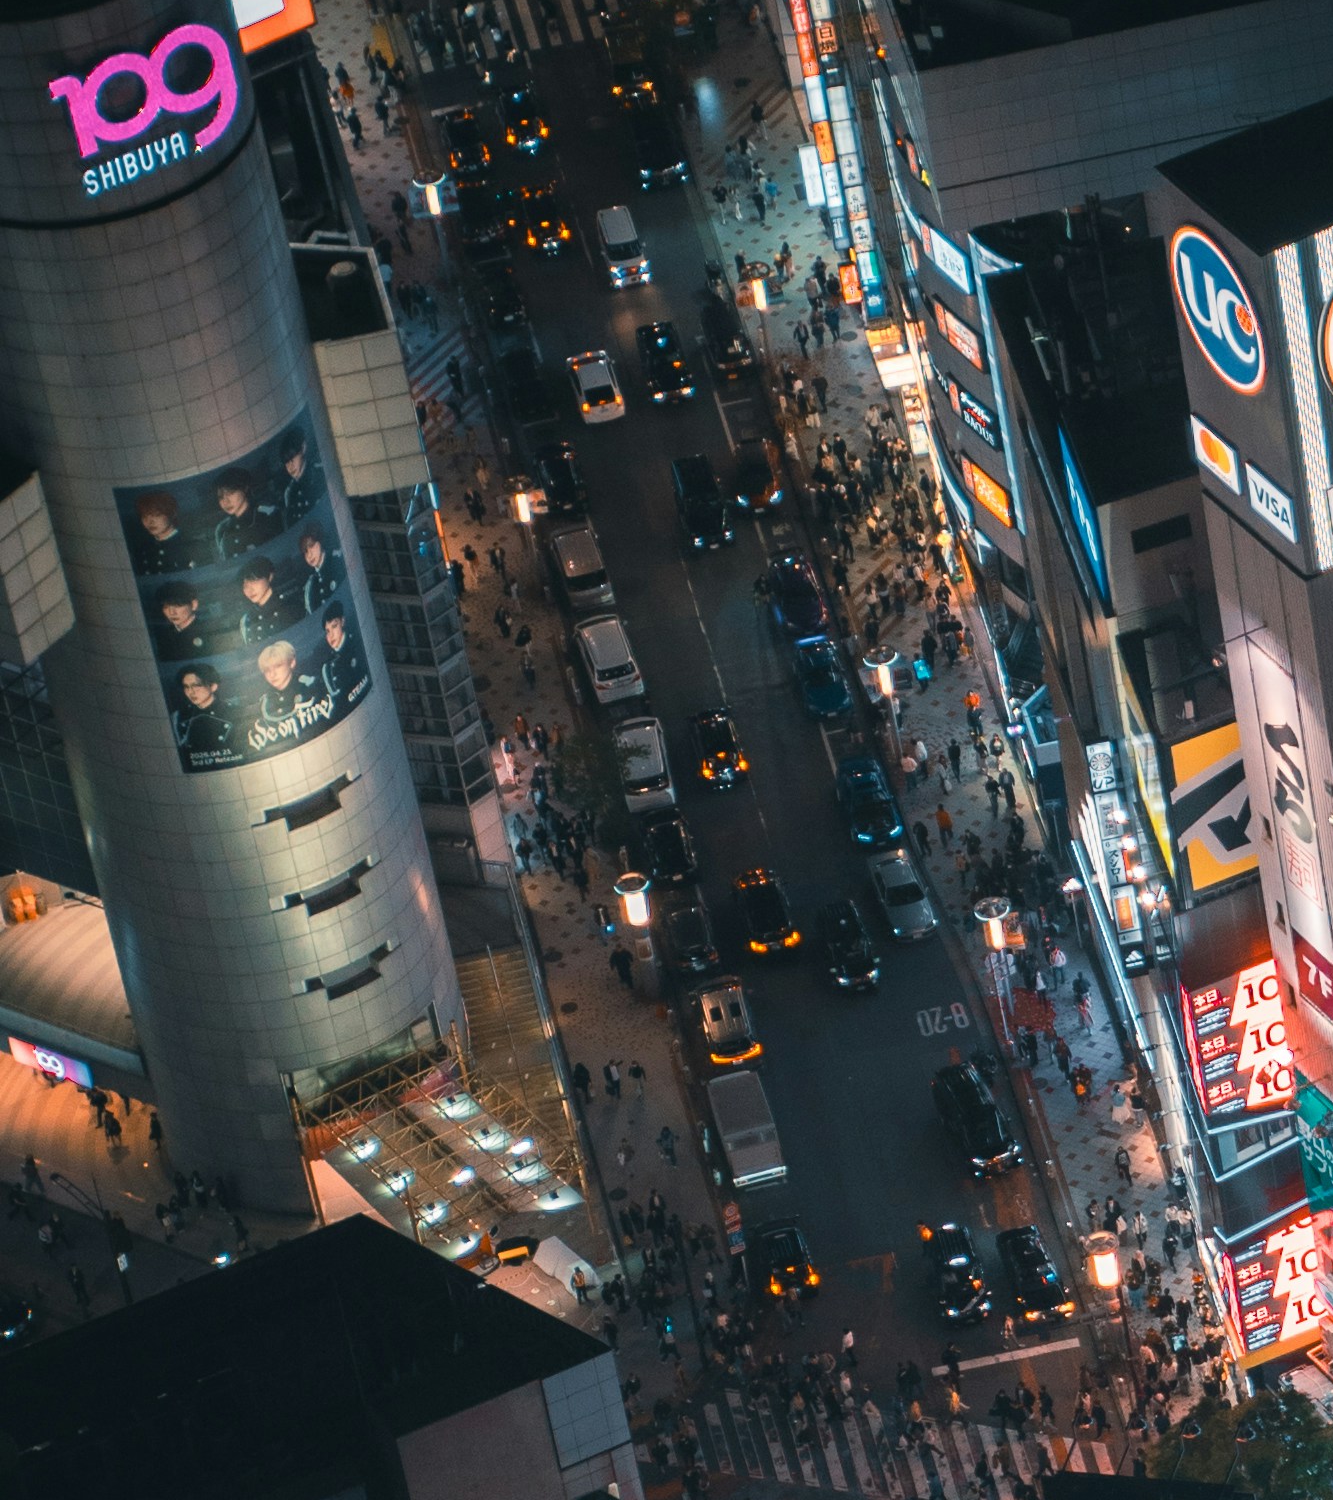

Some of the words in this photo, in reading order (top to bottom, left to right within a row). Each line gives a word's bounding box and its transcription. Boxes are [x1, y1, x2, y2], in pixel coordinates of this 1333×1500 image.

[49, 23, 238, 160] 109
[82, 132, 188, 198] SHIBUYA
[1252, 485, 1292, 531] VISA
[248, 718, 279, 750] We
[279, 717, 301, 740] on
[294, 694, 336, 729] Fire
[1302, 953, 1333, 999] 7F
[1192, 989, 1218, 1008] 本日
[1200, 1034, 1226, 1052] 本日
[33, 1048, 65, 1078] 109
[1208, 1081, 1233, 1099] 本日
[1236, 1263, 1264, 1281] 本日
[1244, 1306, 1270, 1326] 本日
